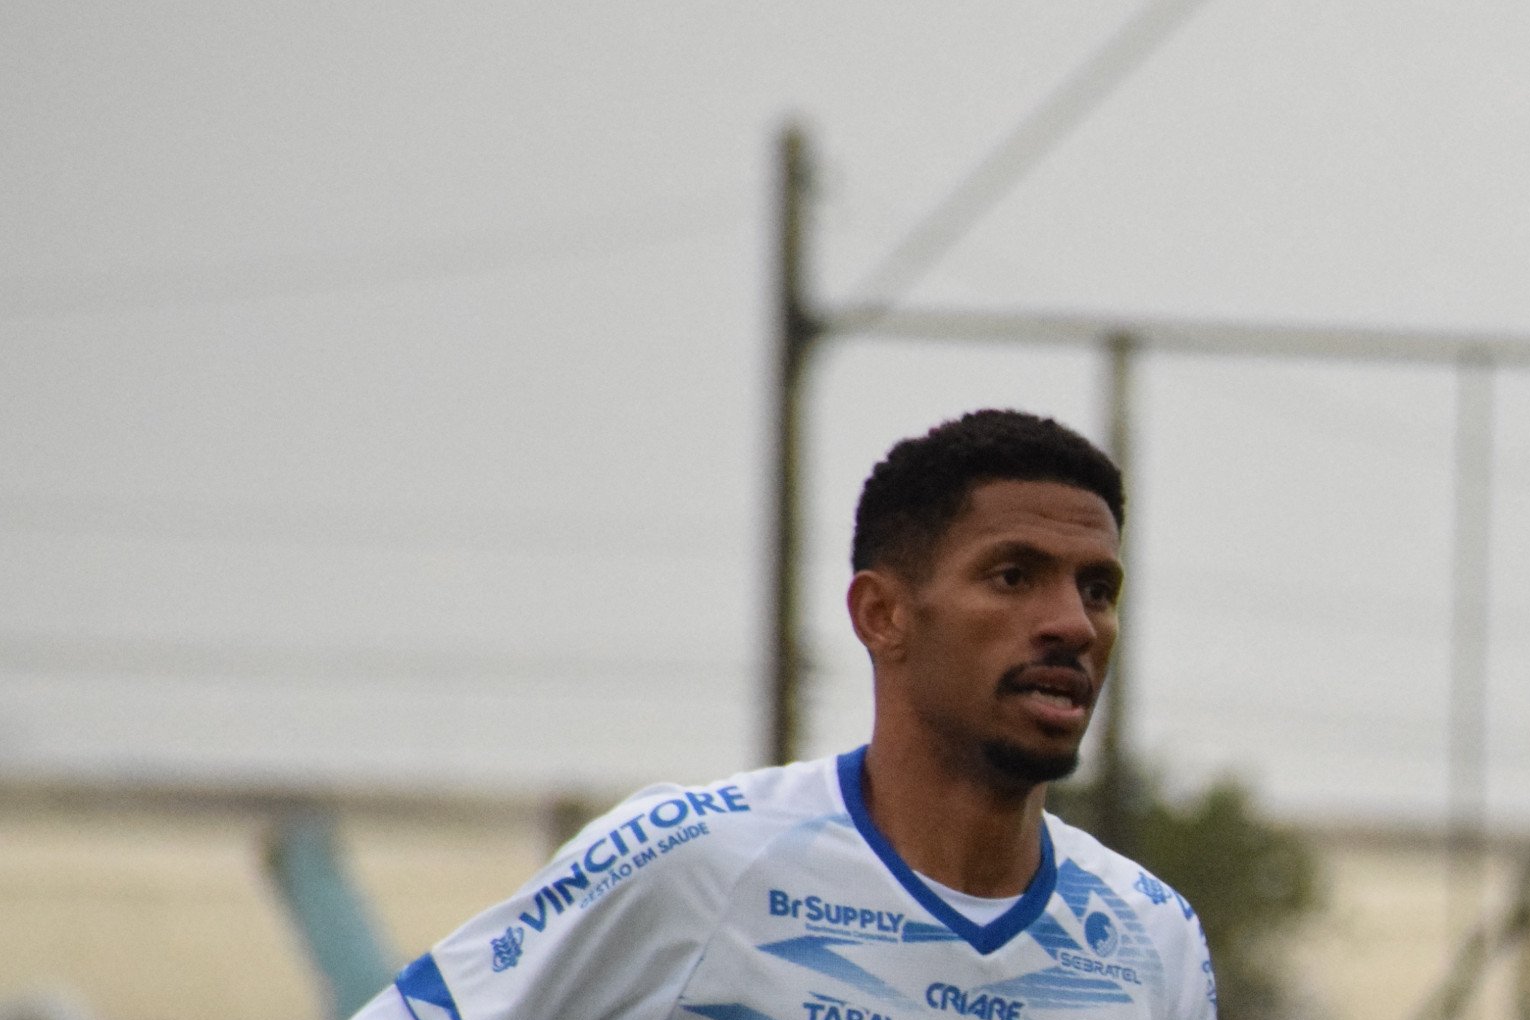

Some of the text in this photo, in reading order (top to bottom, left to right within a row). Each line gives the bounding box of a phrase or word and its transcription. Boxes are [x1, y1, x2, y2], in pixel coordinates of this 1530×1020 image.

[518, 785, 751, 933] VINCITORE
[632, 847, 658, 869] EM
[657, 822, 711, 855] SAÚDE
